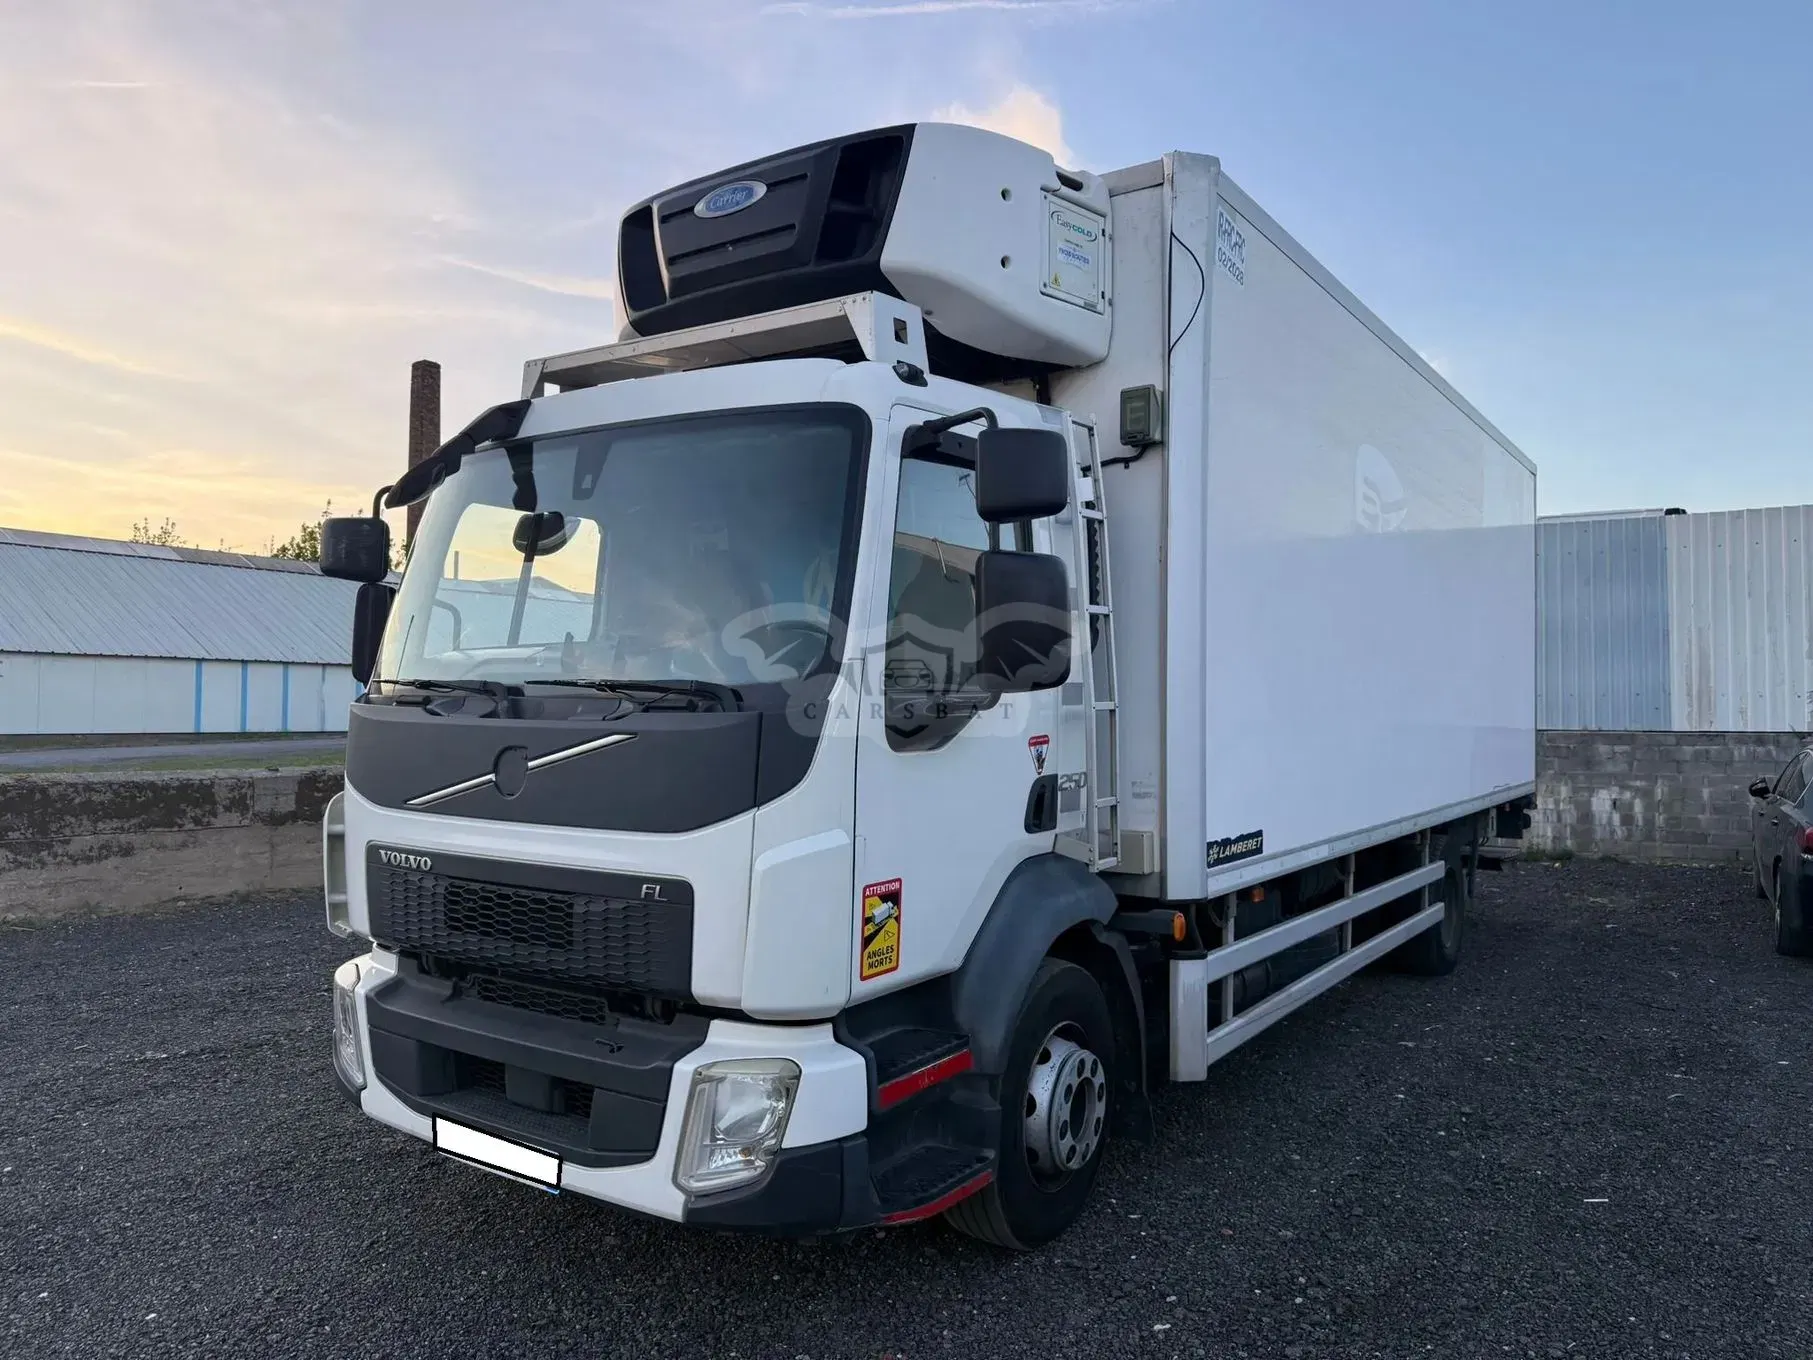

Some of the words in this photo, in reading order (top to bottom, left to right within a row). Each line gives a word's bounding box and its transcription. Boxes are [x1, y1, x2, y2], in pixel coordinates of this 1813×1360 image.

[710, 190, 749, 209] Carrier
[1219, 837, 1263, 858] LAMBERET
[379, 849, 432, 871] VOLVO
[640, 884, 668, 901] FL
[864, 881, 900, 897] ATTENTION
[867, 944, 895, 961] ANGLES
[867, 955, 893, 970] MORTS
